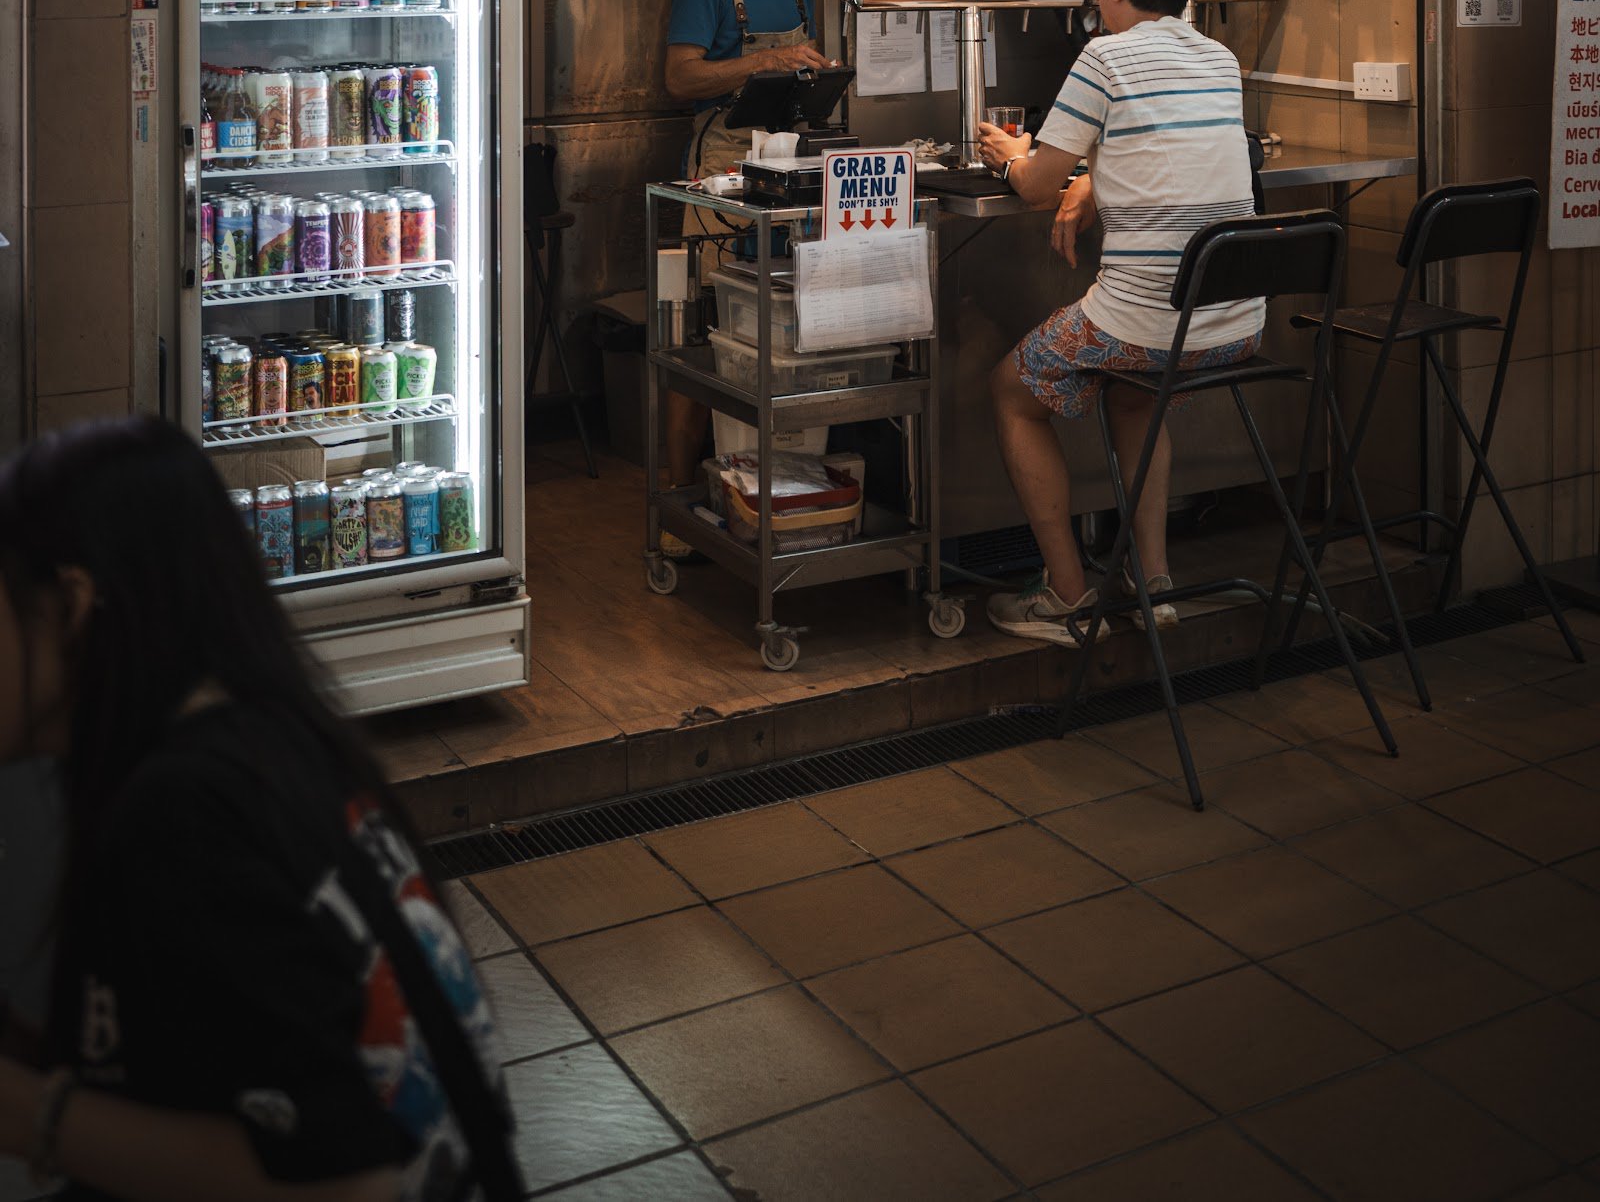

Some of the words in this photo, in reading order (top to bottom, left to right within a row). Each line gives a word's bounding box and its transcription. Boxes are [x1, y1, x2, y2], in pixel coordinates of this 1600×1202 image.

[833, 156, 886, 178] GRAB
[893, 155, 906, 175] A
[1565, 149, 1588, 165] Bia
[840, 176, 897, 198] MENU
[839, 199, 865, 210] DON'T
[867, 198, 877, 208] BE
[880, 197, 898, 207] SHY!
